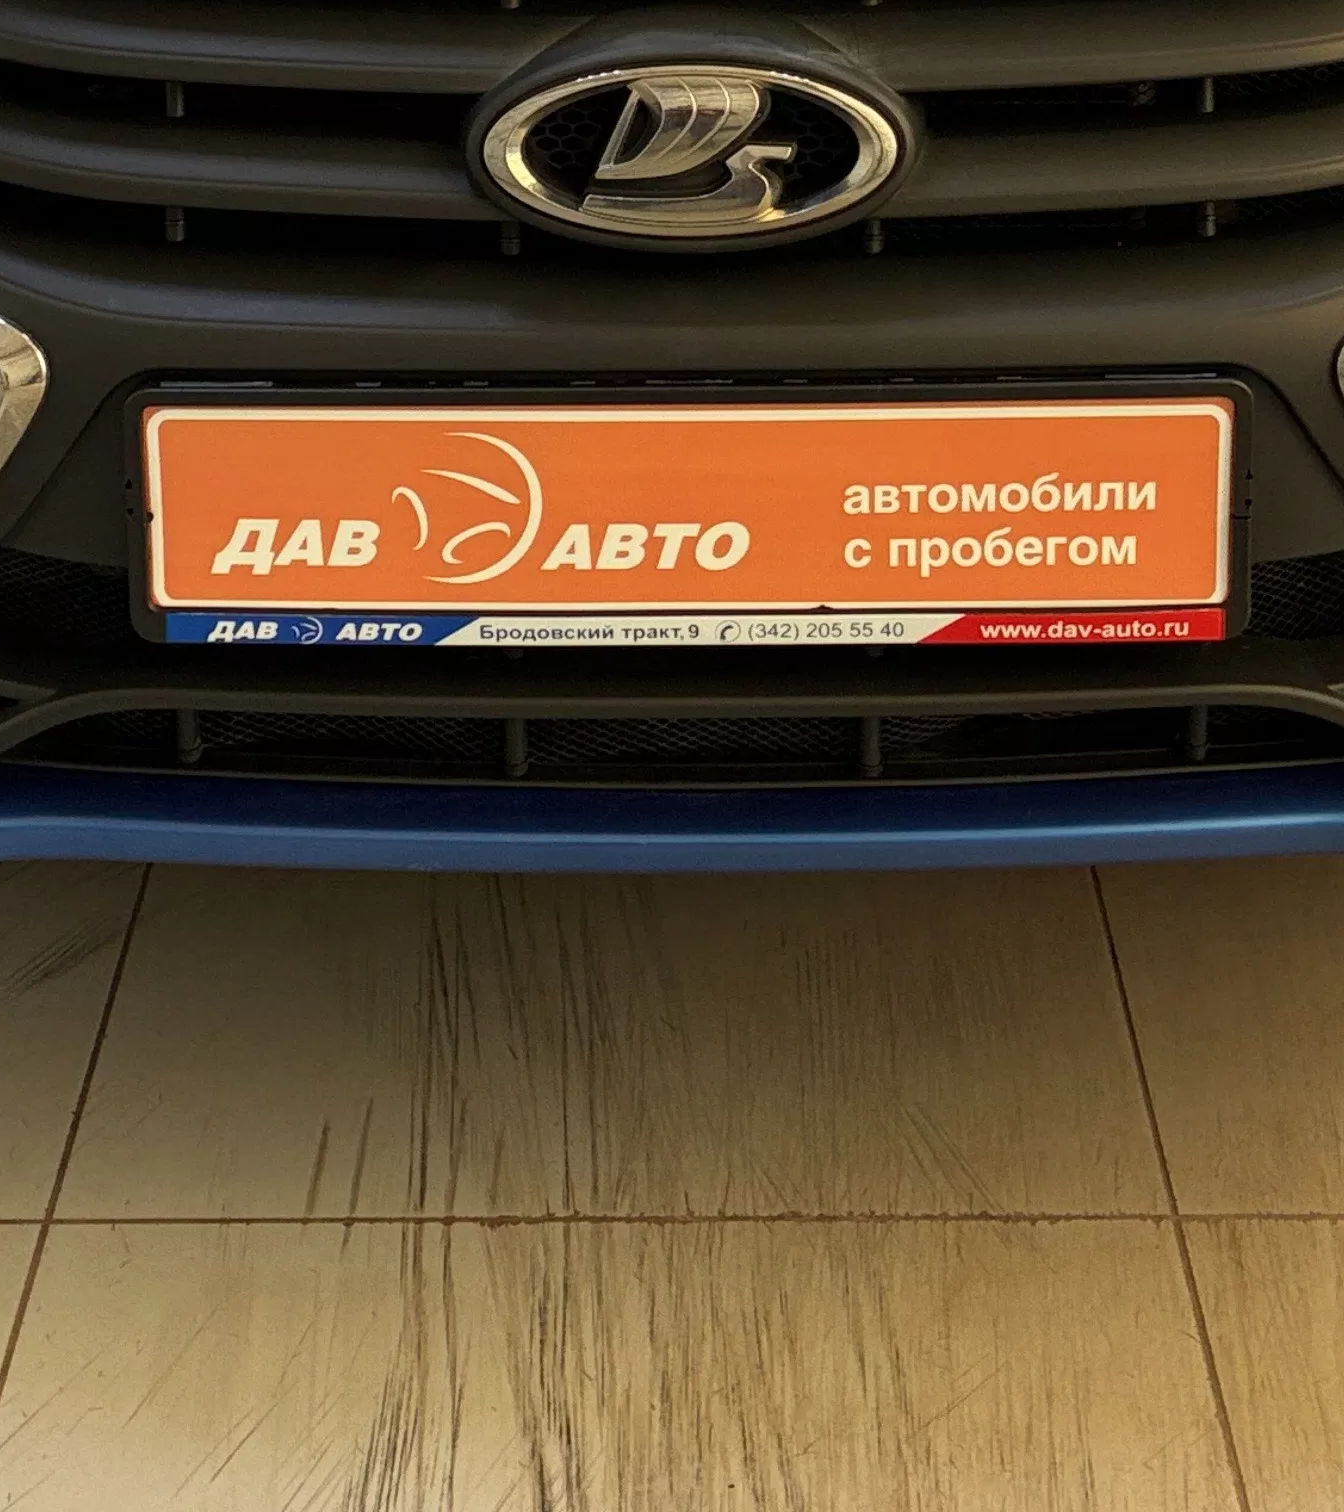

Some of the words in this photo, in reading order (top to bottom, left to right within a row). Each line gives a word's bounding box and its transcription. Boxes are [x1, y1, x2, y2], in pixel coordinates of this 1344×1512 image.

[843, 472, 1157, 515] автомобили
[210, 518, 381, 575] ДАВ
[539, 521, 752, 571] АВТО
[843, 537, 872, 568] с
[888, 526, 1138, 578] пробегом
[207, 620, 279, 643] ДАВ
[335, 622, 424, 642] АВТО
[478, 624, 615, 643] Бродовский
[747, 621, 800, 641] (342)
[805, 621, 843, 638] 205
[849, 621, 874, 638] 55
[879, 620, 905, 638] 40
[979, 620, 1190, 641] www.dav-auto.ru
